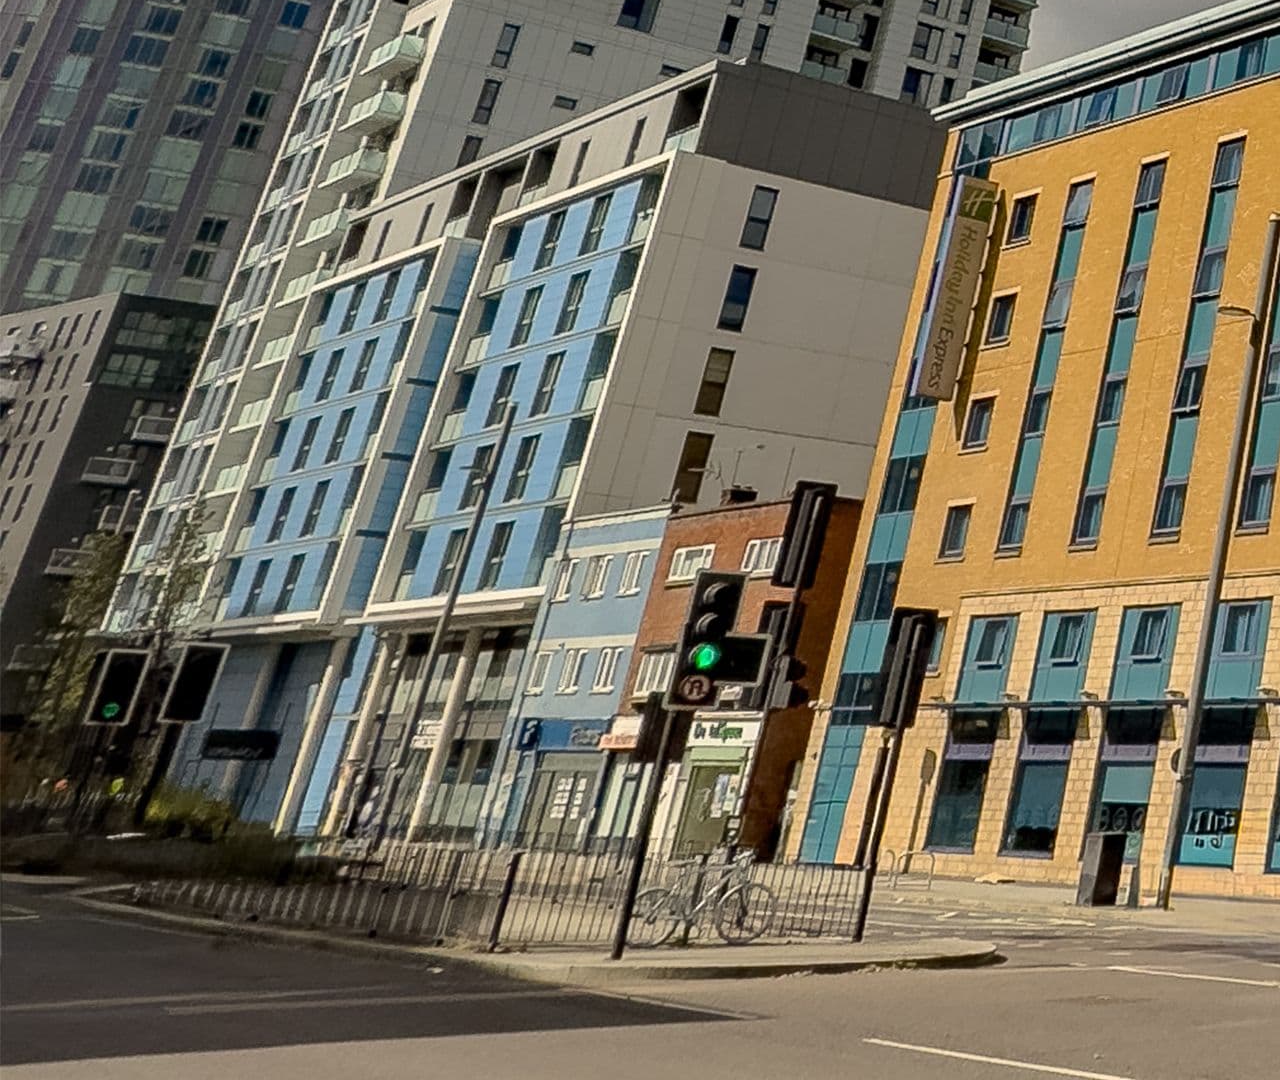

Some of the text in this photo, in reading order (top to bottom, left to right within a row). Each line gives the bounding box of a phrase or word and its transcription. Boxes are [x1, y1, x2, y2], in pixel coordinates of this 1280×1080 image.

[928, 225, 977, 391] Holiday Inn Express
